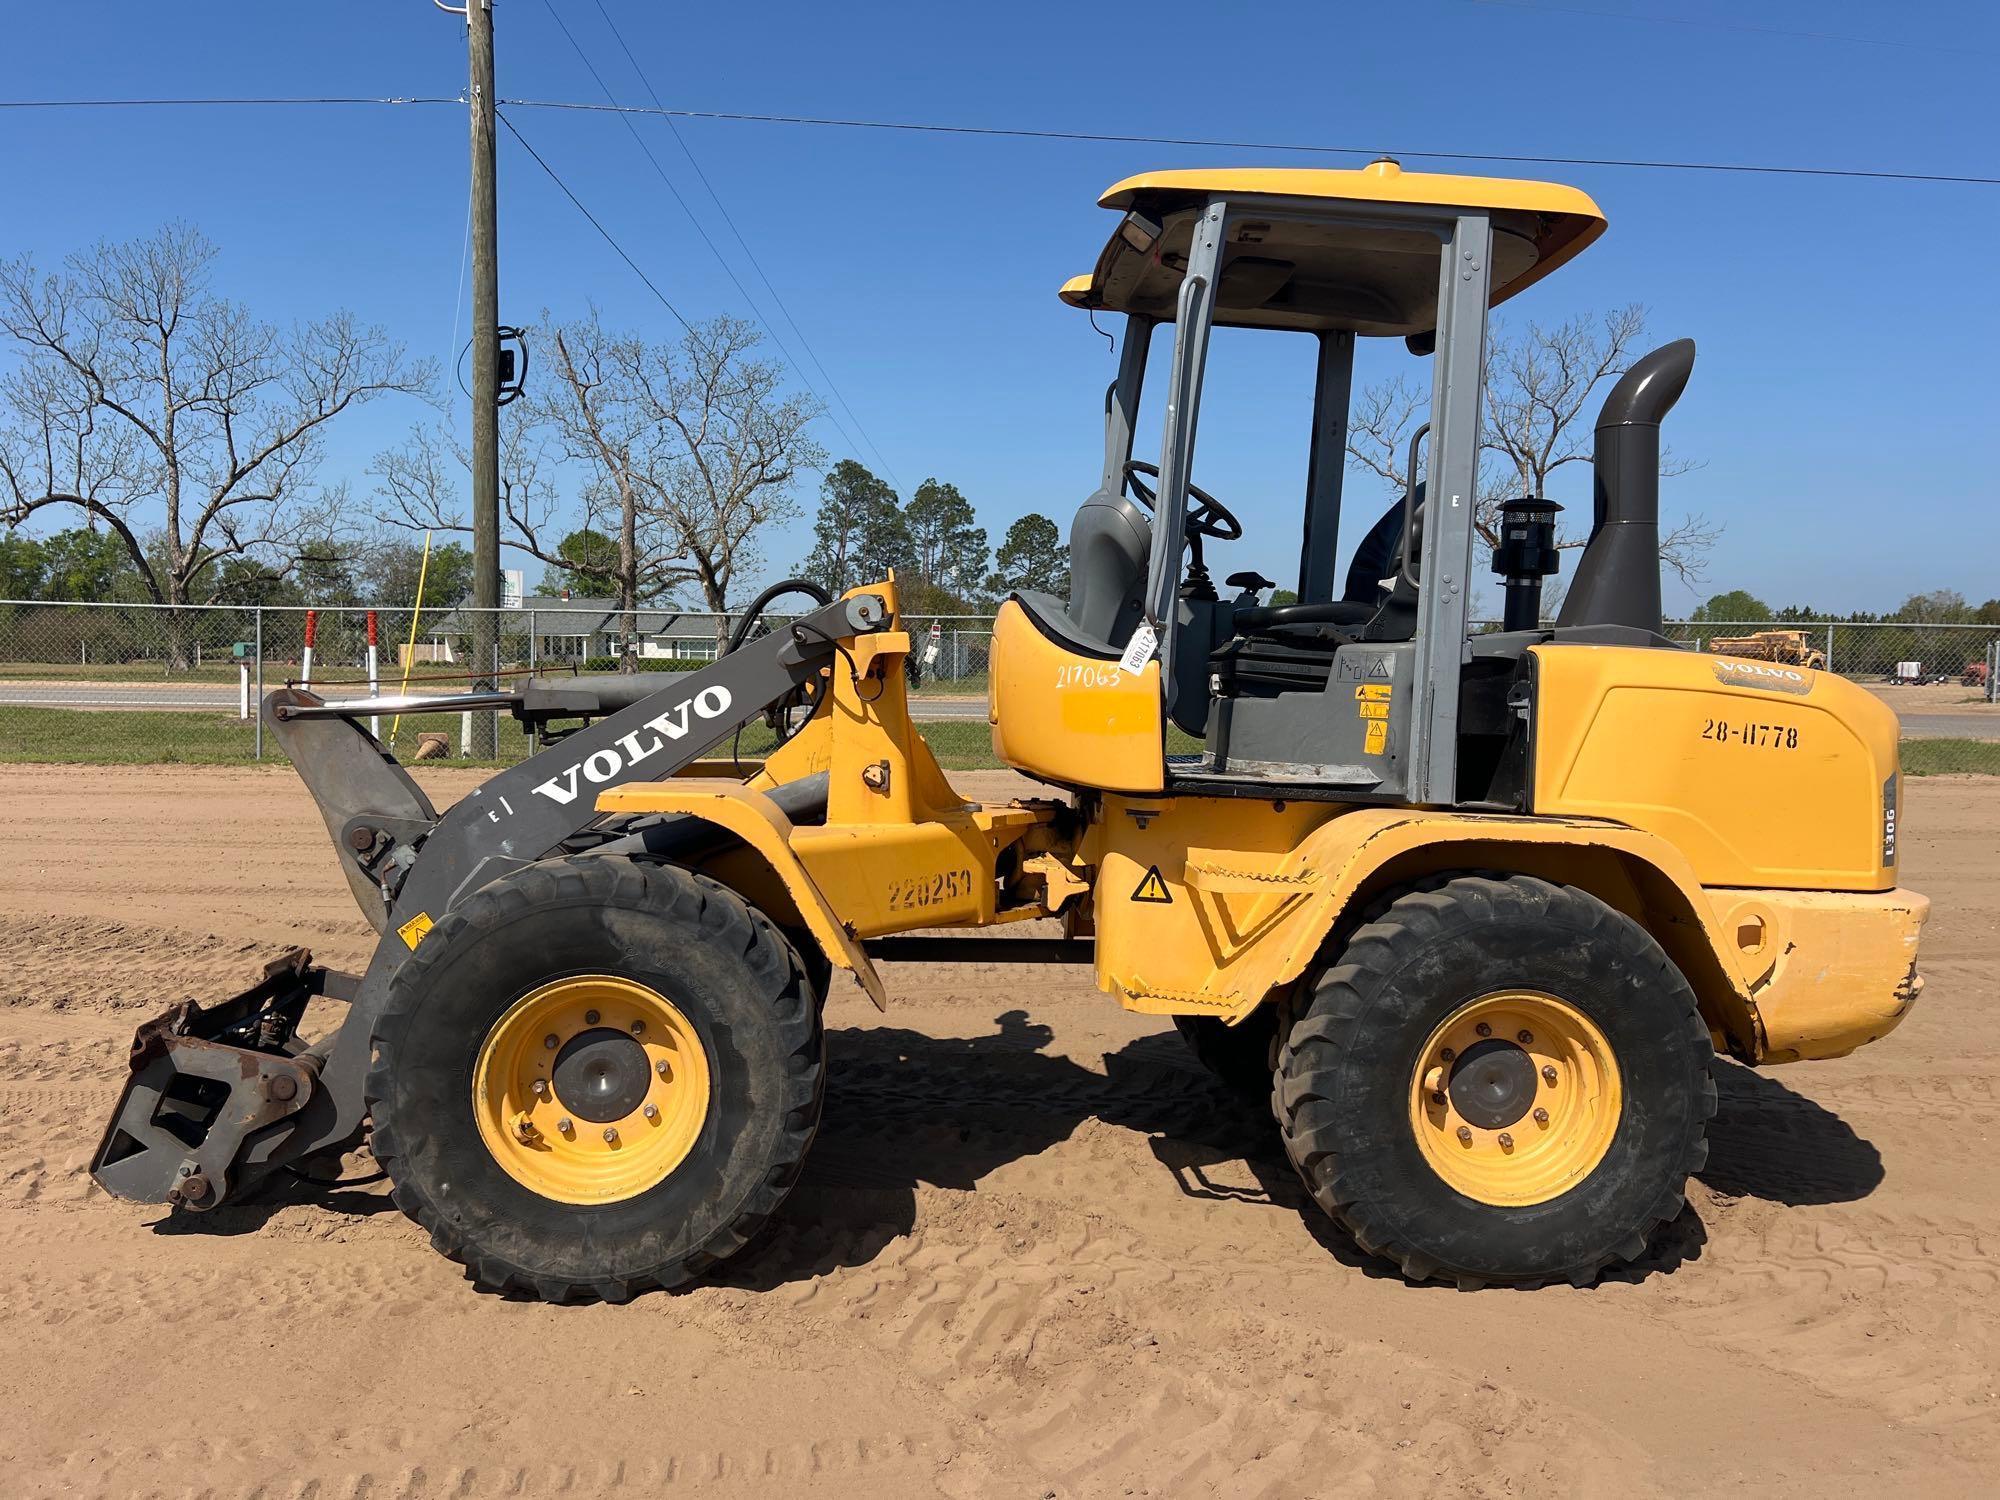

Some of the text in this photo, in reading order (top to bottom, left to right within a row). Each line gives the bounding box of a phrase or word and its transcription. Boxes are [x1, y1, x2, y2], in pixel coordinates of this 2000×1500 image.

[1451, 495, 1460, 507] E
[1129, 635, 1154, 669] 217063
[1055, 664, 1121, 689] 217063
[1713, 660, 1803, 681] VOLVO
[530, 685, 732, 805] VOLVO
[1702, 718, 1798, 749] 28-11778
[1885, 809, 1895, 856] L30G
